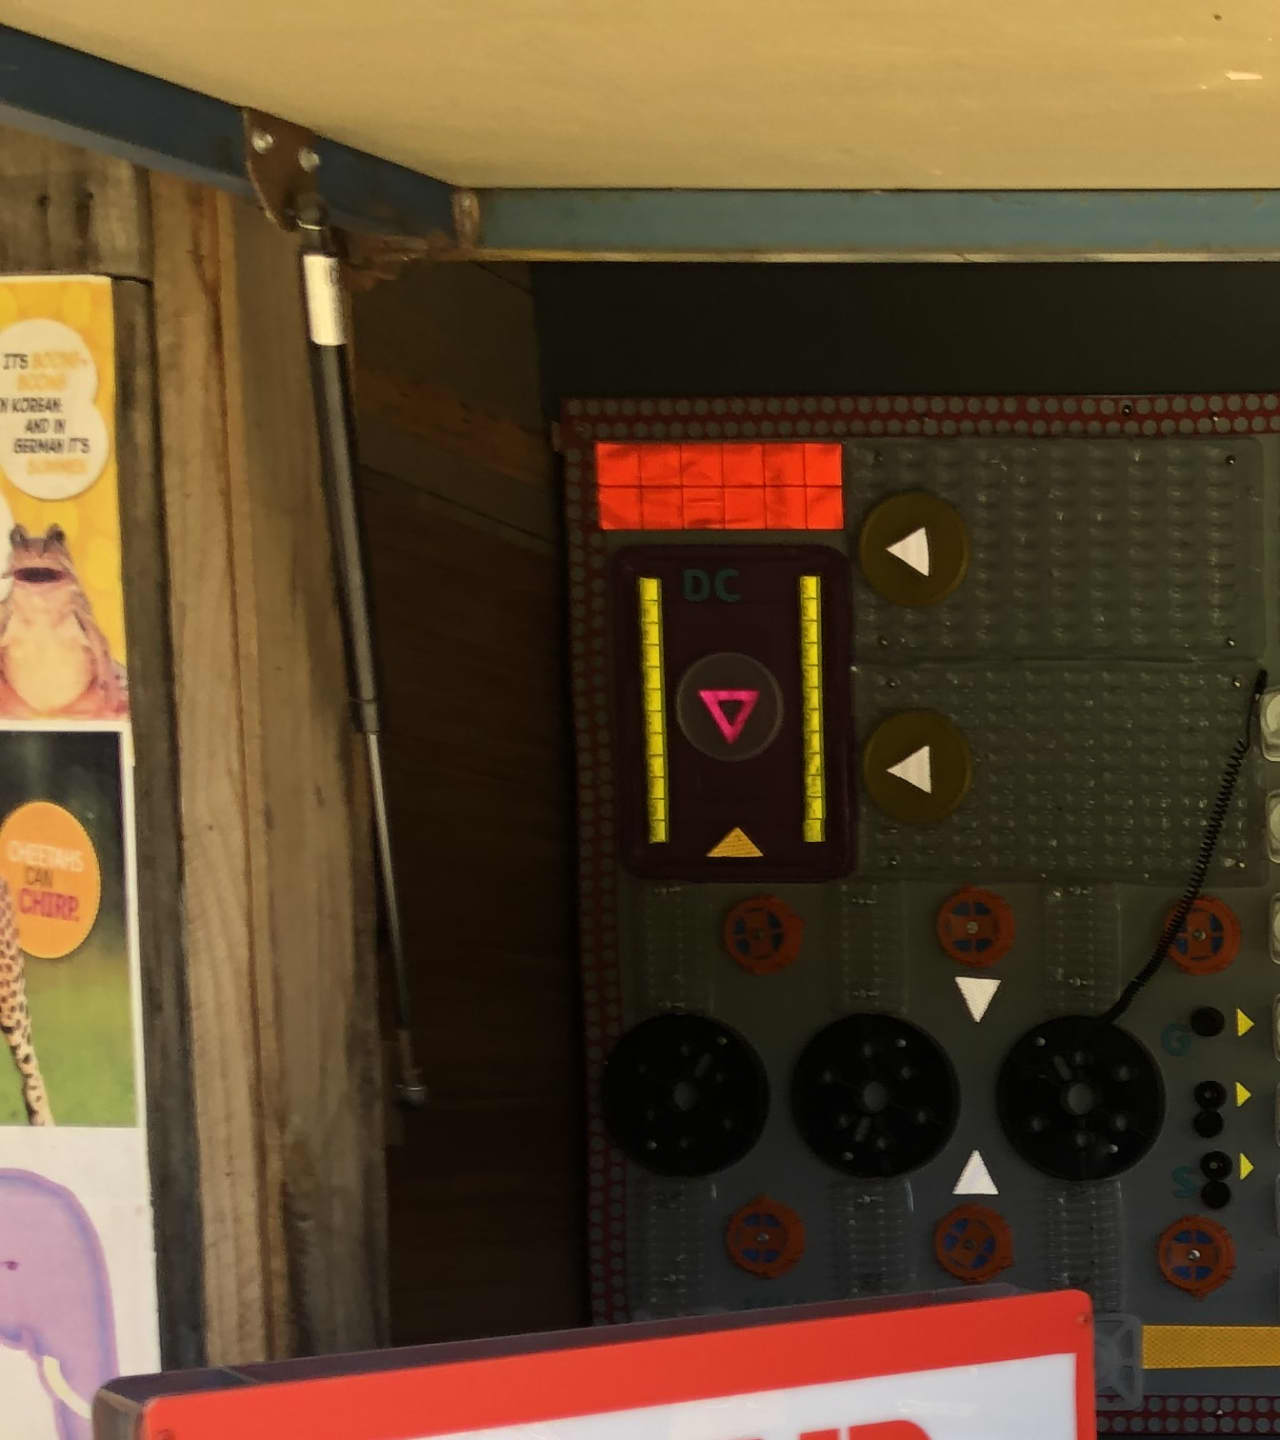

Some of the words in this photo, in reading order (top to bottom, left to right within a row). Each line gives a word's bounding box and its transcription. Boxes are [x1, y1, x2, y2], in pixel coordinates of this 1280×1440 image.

[25, 418, 49, 434] AND
[54, 418, 65, 434] IN
[682, 568, 742, 602] DC
[25, 865, 53, 888] CAN
